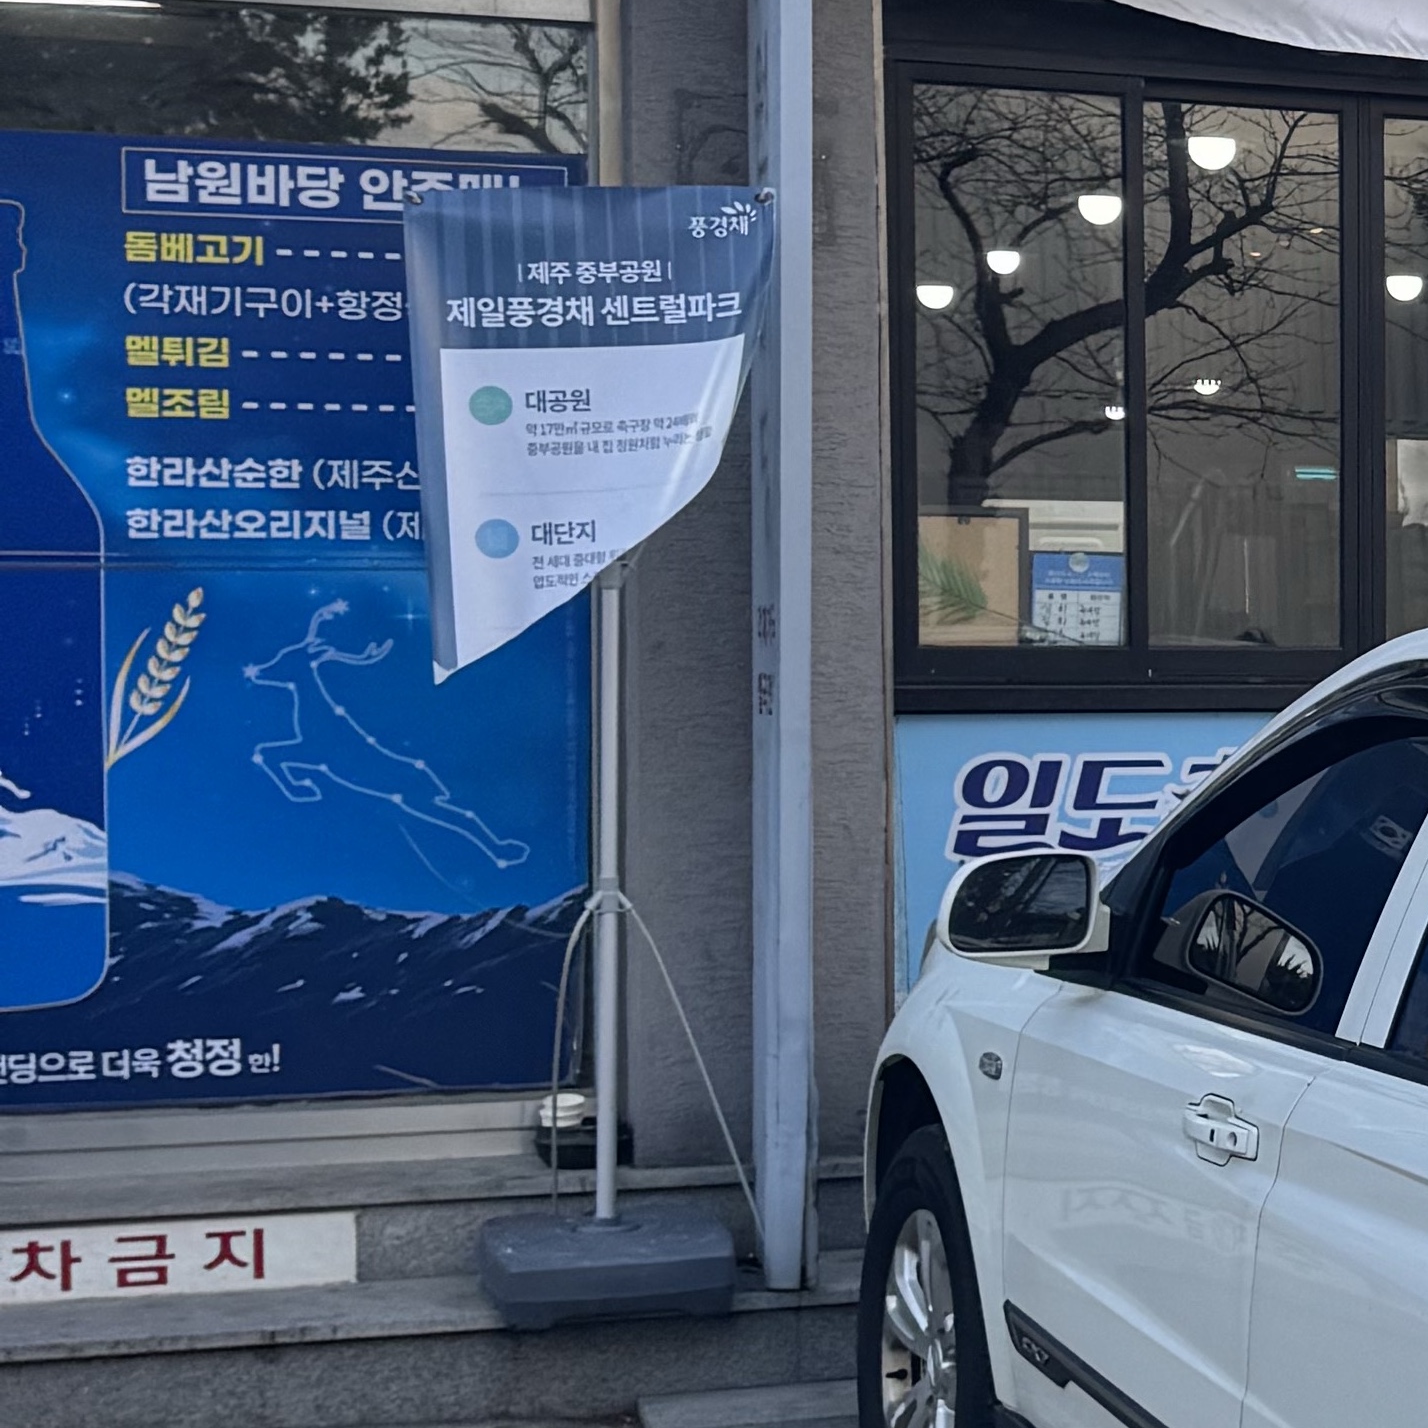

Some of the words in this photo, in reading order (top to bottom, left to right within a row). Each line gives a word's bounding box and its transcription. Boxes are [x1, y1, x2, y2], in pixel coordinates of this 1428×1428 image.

[144, 159, 344, 209] 남원바당
[124, 231, 264, 266] 돔베고기
[527, 261, 572, 285] 제주
[575, 260, 662, 284] 중부공원
[124, 282, 409, 322] (각재기구이+항정
[447, 296, 594, 328] 제일풍경채
[601, 292, 743, 326] 센트럴파크
[125, 335, 230, 367] 멜튀김
[125, 387, 230, 419] 멜조림
[525, 388, 592, 413] 대공원
[126, 456, 302, 489] 한라산순한
[126, 509, 371, 541] 한라산오리지널
[531, 520, 596, 546] 대단지
[953, 754, 1232, 857] 일도
[101, 1048, 162, 1080] 더욱
[166, 1038, 242, 1078] 청정
